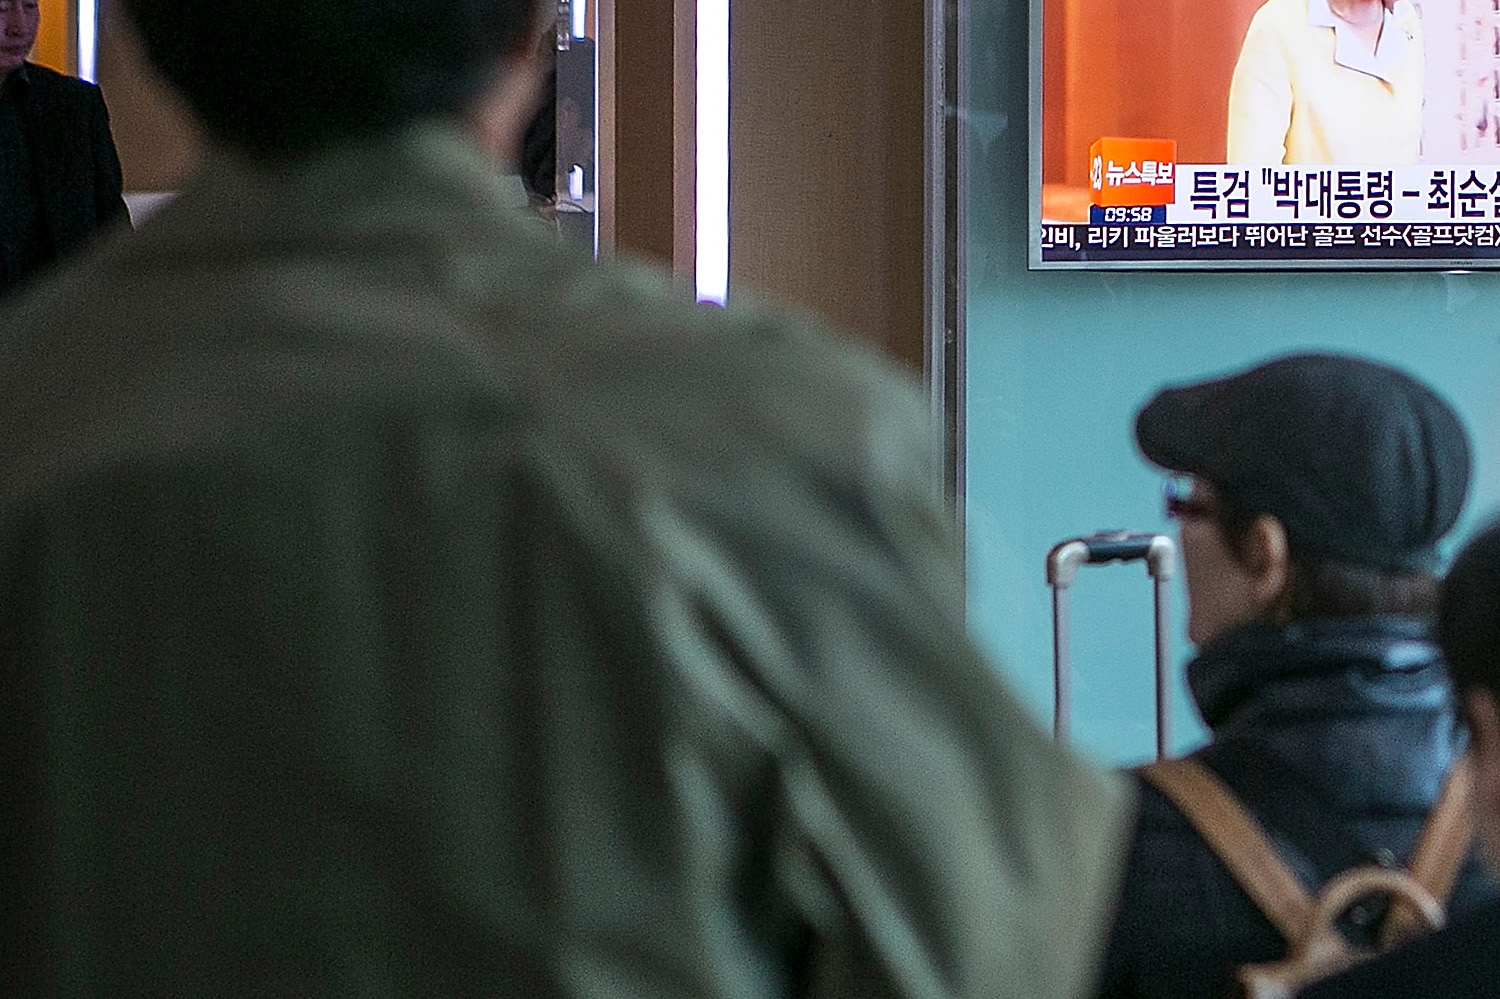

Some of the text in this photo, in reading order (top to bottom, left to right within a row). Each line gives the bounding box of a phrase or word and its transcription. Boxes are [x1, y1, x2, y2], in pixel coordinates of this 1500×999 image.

[1105, 160, 1174, 186] 뉴스특보
[1190, 169, 1250, 219] 특검
[1262, 167, 1394, 219] "박대통령
[1104, 207, 1153, 223] 09:58
[1087, 226, 1129, 248] 리키
[1134, 226, 1240, 248] 파울러보다
[1244, 226, 1309, 248] 뛰어난
[1312, 226, 1355, 247] 골프
